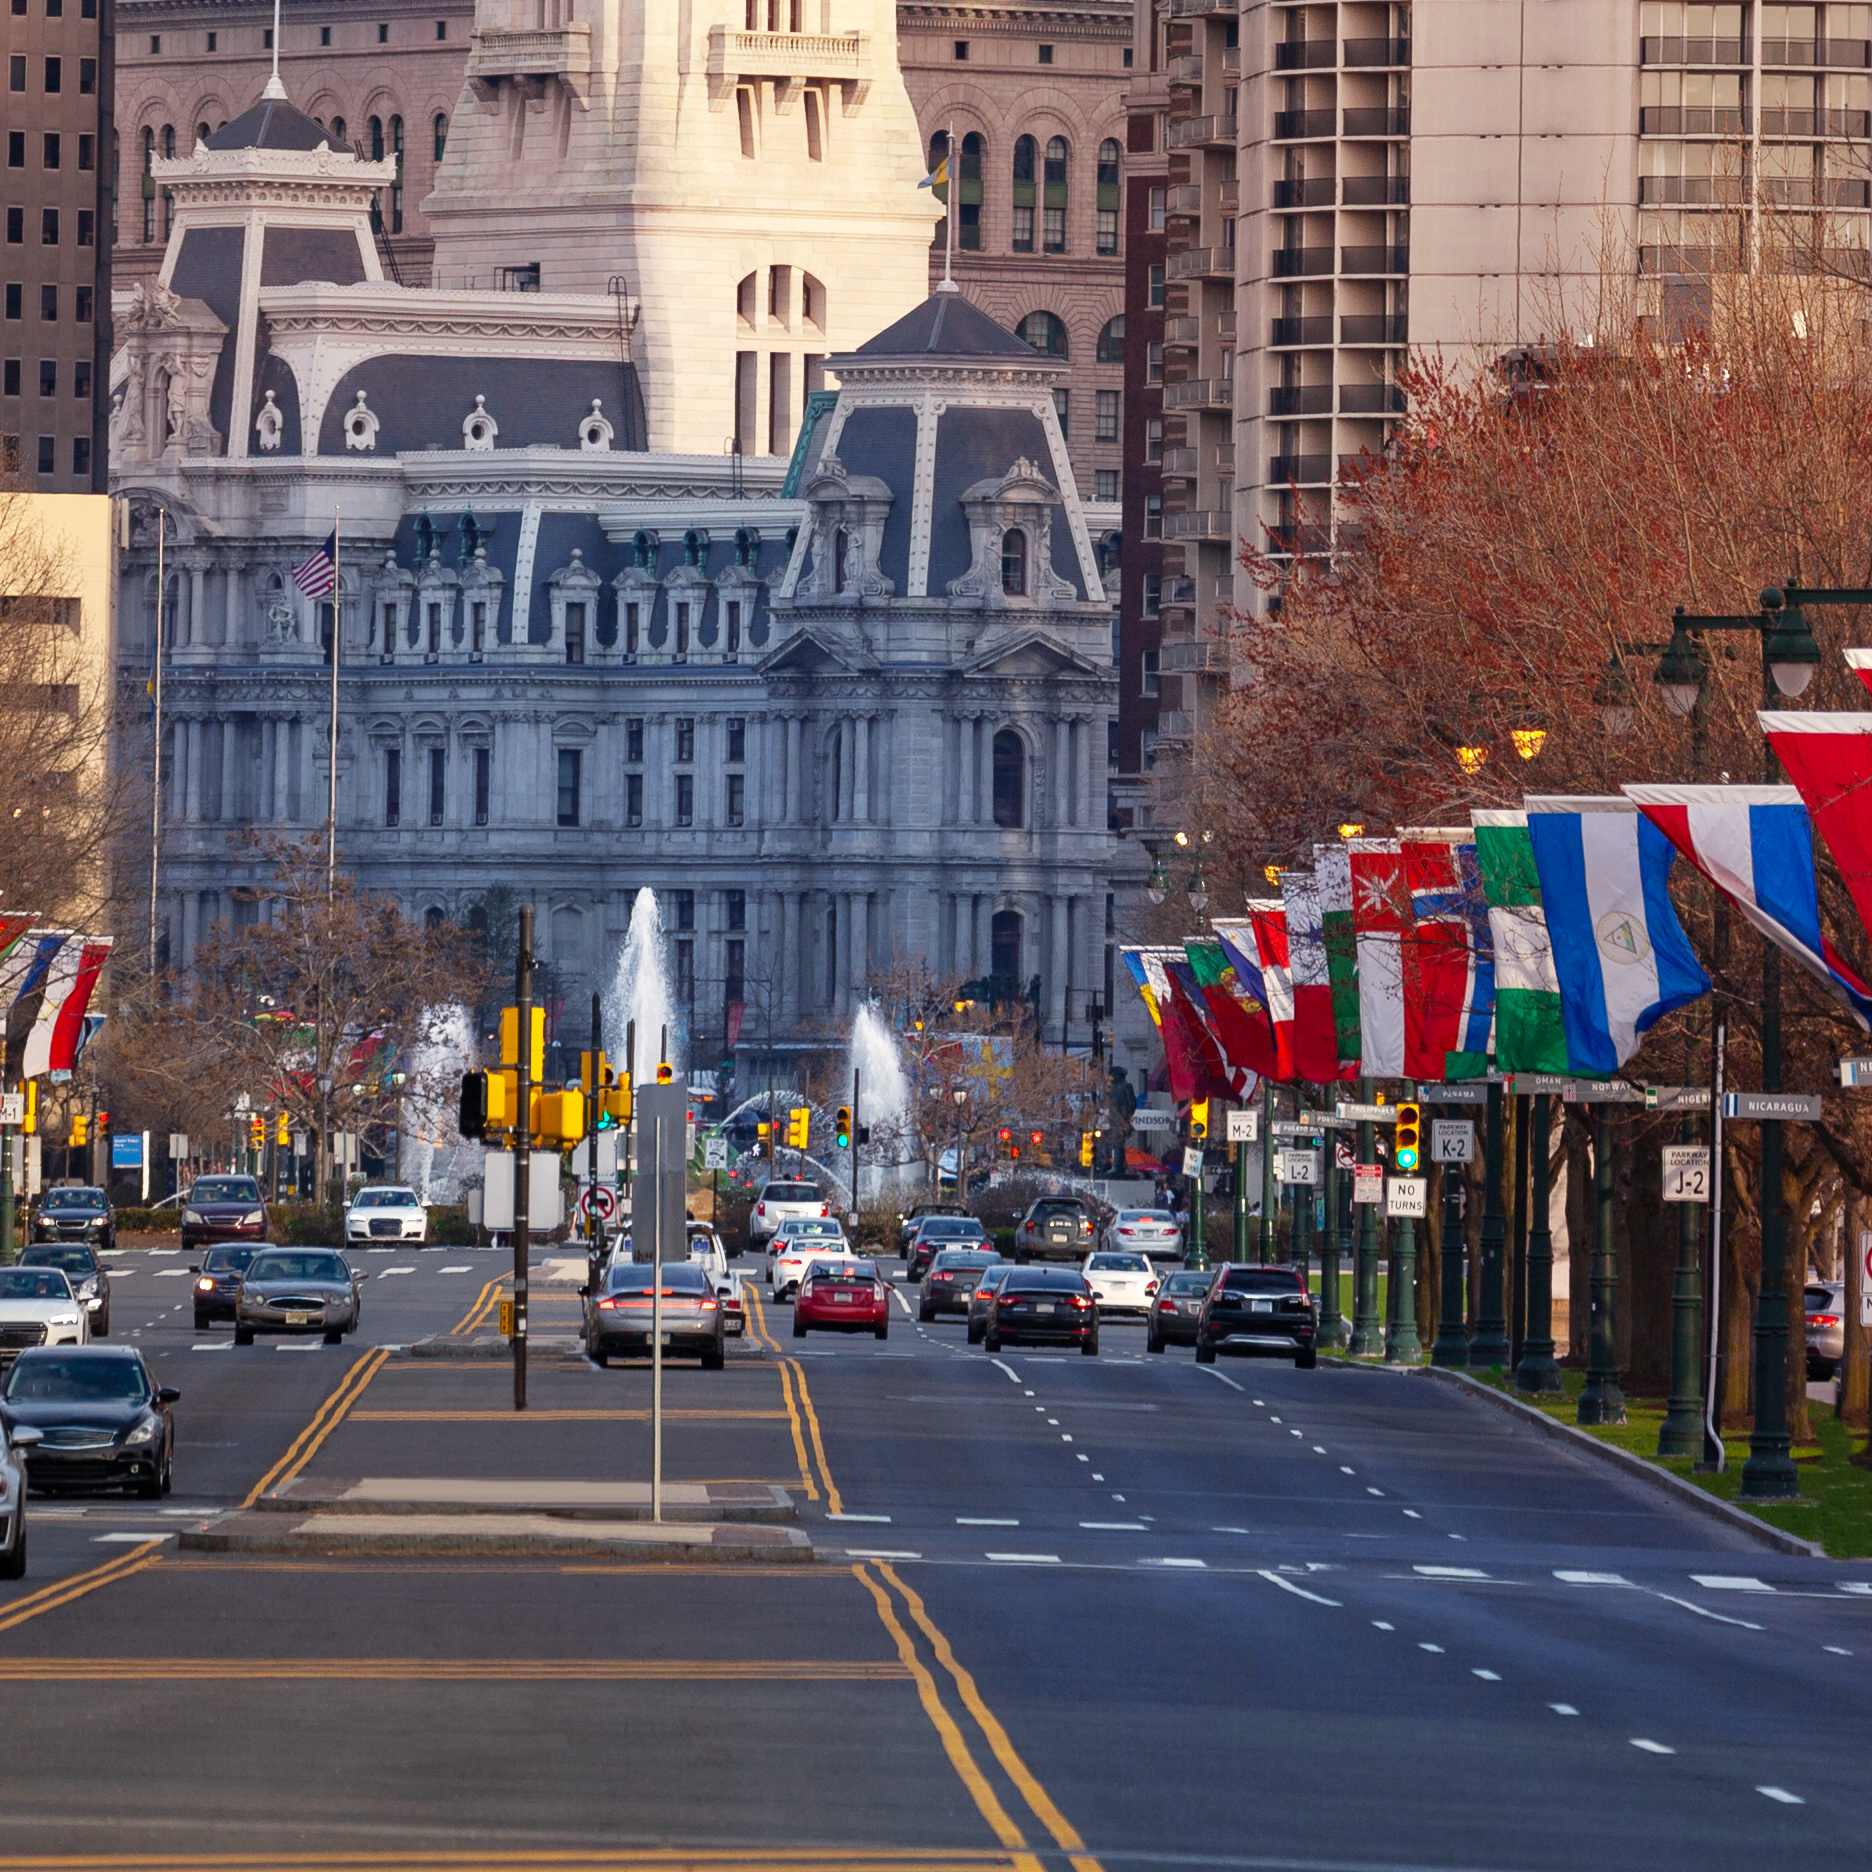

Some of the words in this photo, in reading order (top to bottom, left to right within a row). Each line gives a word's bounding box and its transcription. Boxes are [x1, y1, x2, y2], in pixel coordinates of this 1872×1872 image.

[1535, 1076, 1562, 1086] OMAN
[1591, 1083, 1631, 1092] NORWAY
[1442, 1090, 1475, 1099] PANAMA
[1748, 1101, 1810, 1113] NICARAGUA
[1233, 1124, 1252, 1138] M-2
[1441, 1139, 1466, 1158] K-2
[1671, 1151, 1708, 1159] PARKWAY
[1670, 1159, 1709, 1167] LOCATION
[1291, 1164, 1309, 1180] L-2
[1675, 1170, 1704, 1195] J-2
[1398, 1184, 1415, 1196] NO
[1390, 1200, 1423, 1211] TURNS
